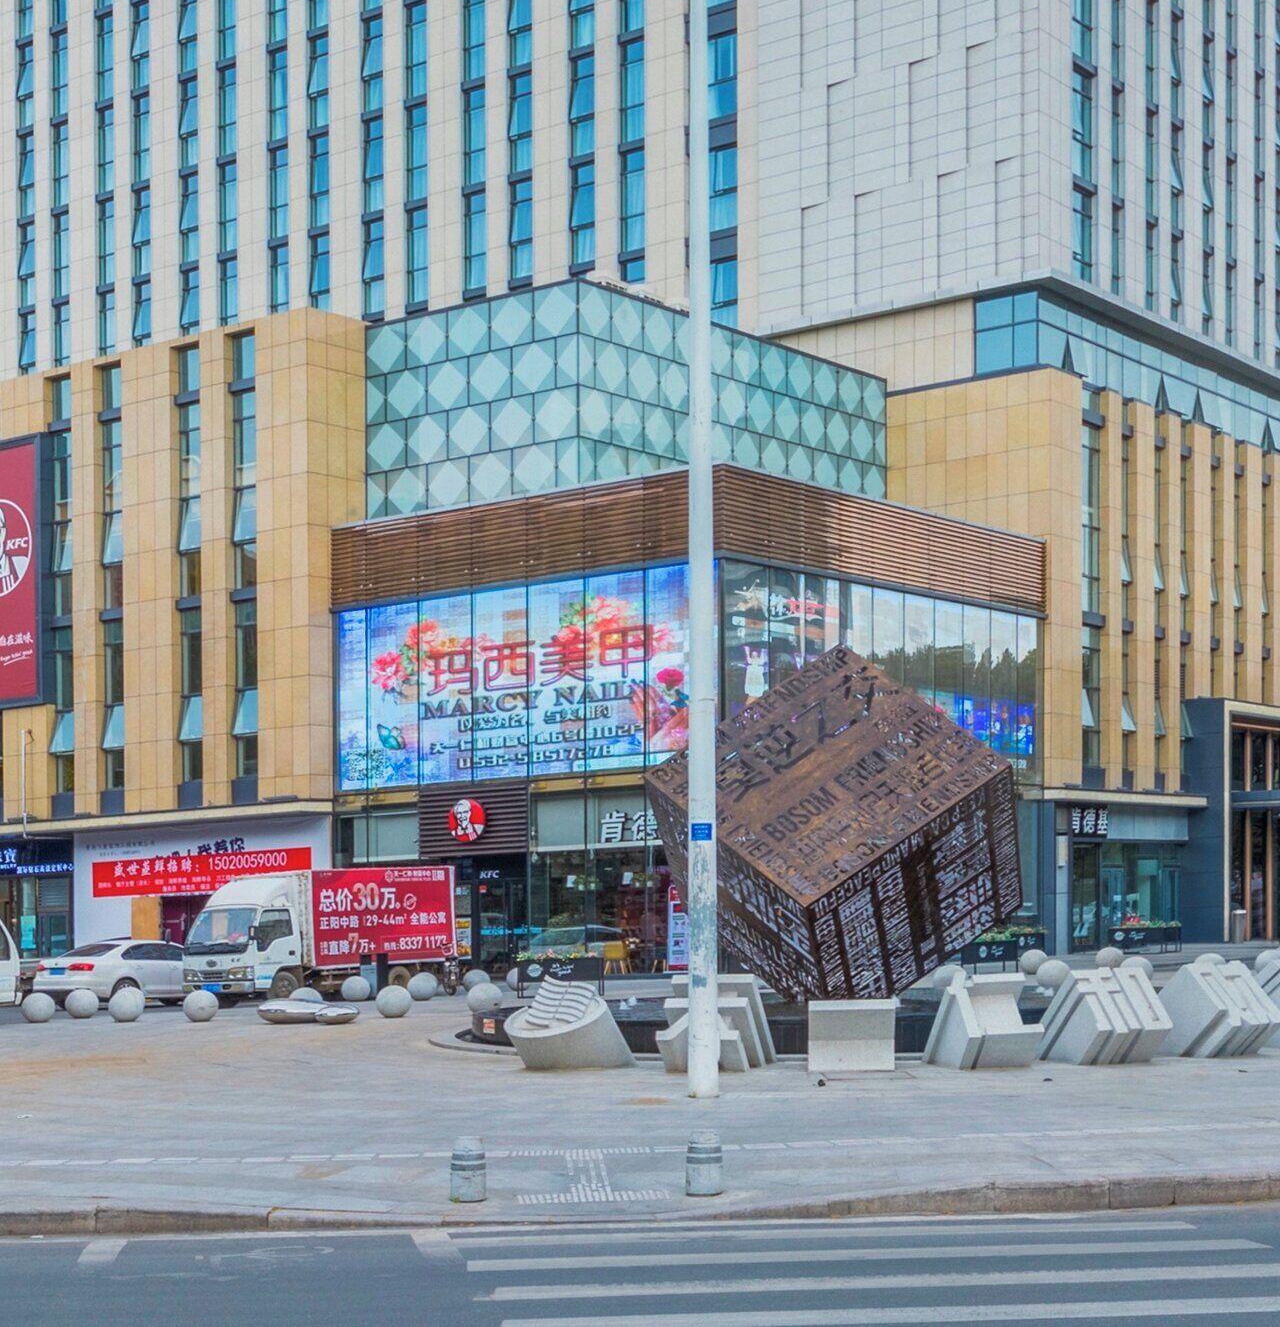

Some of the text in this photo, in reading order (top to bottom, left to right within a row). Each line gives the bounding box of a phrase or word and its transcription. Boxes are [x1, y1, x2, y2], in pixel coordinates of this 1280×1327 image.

[6, 537, 28, 550] KFC
[0, 631, 34, 648] 自在滋味
[426, 623, 655, 696] 玛西美甲
[421, 679, 635, 720] MARCY NAIL
[761, 786, 841, 842] BOSOM
[1072, 807, 1109, 834] 肯德基
[208, 852, 288, 872] 15020059000
[480, 870, 500, 879] KFC
[320, 916, 359, 930] 正阳中路
[410, 911, 447, 925] 全能公寓
[328, 932, 376, 955] 直降7万+
